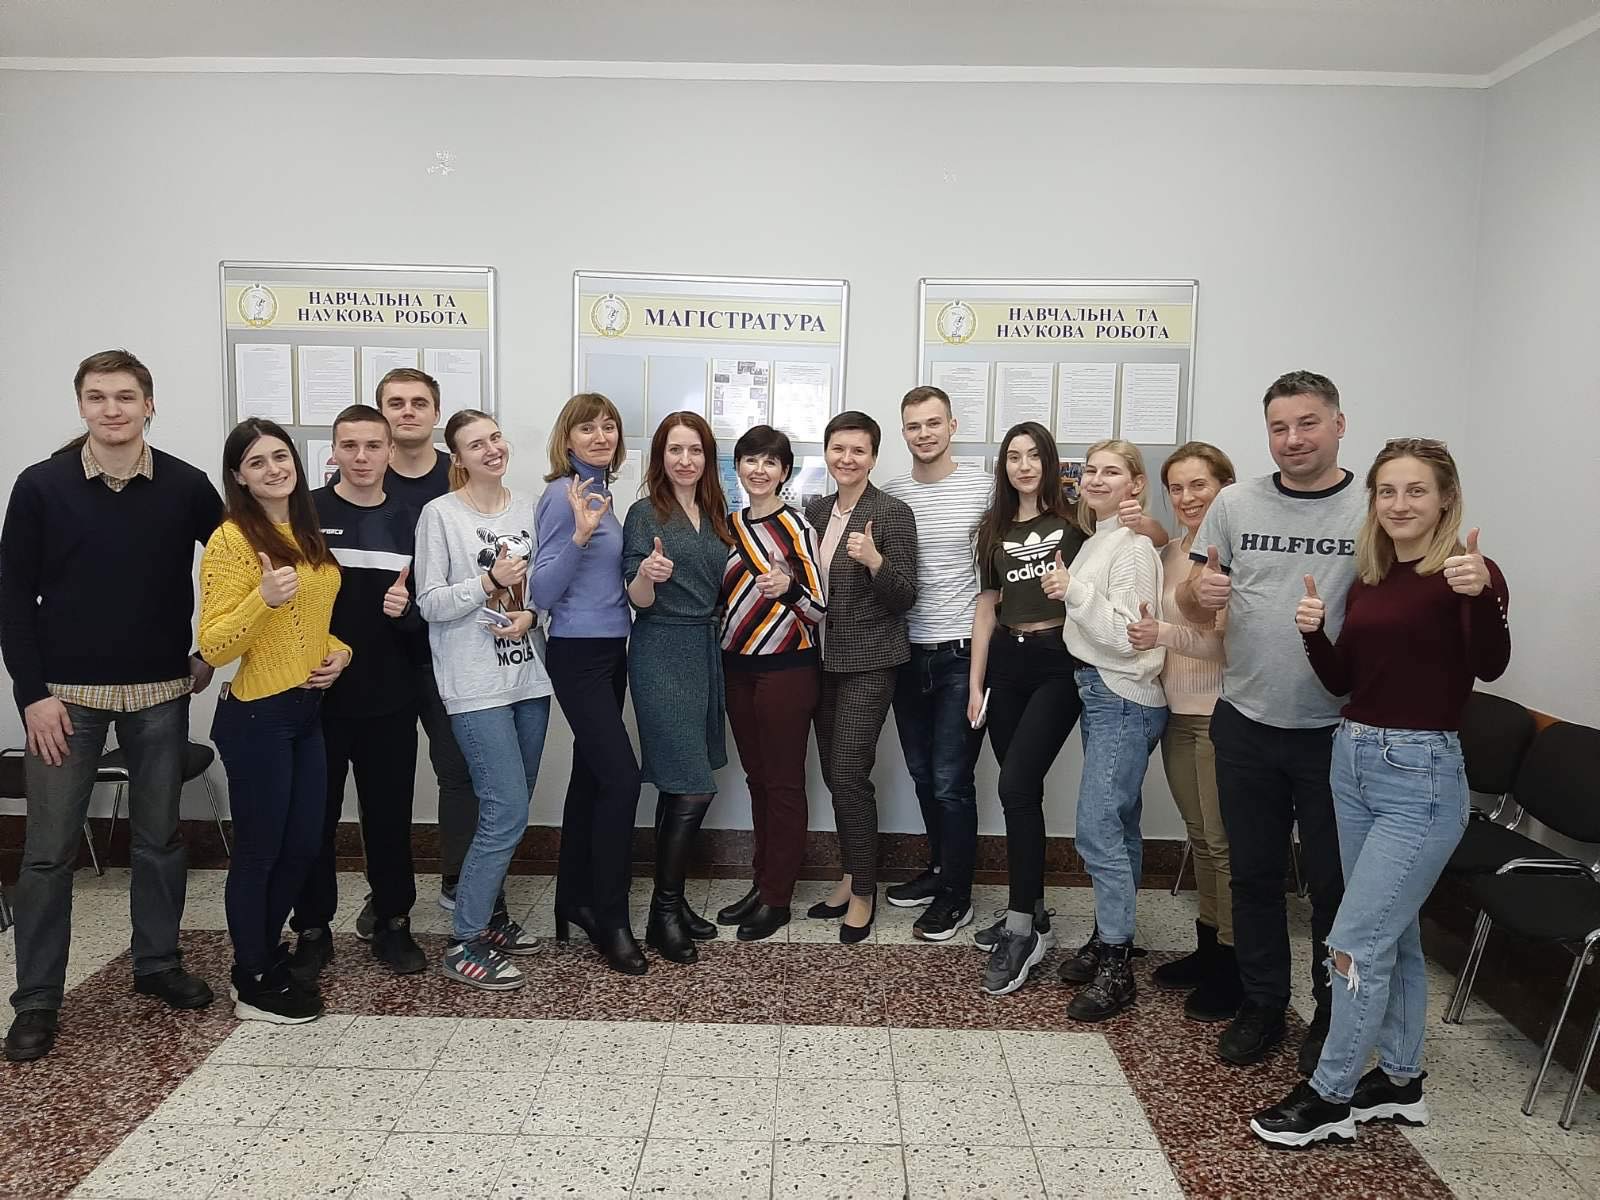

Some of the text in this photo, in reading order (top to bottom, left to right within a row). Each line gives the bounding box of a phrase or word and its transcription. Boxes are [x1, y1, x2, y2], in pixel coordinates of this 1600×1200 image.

[309, 291, 456, 308] НАВЧАЛЬНА ТА
[298, 308, 468, 325] НАУКОВА РОБОТА
[645, 308, 826, 332] МАГІСТРАТУРА
[1009, 308, 1159, 322] НАВЧАЛЬНА ТА
[997, 324, 1169, 339] НАУКОВА РОБОТА
[1240, 533, 1356, 556] HILFIGE
[1006, 560, 1057, 583] adida
